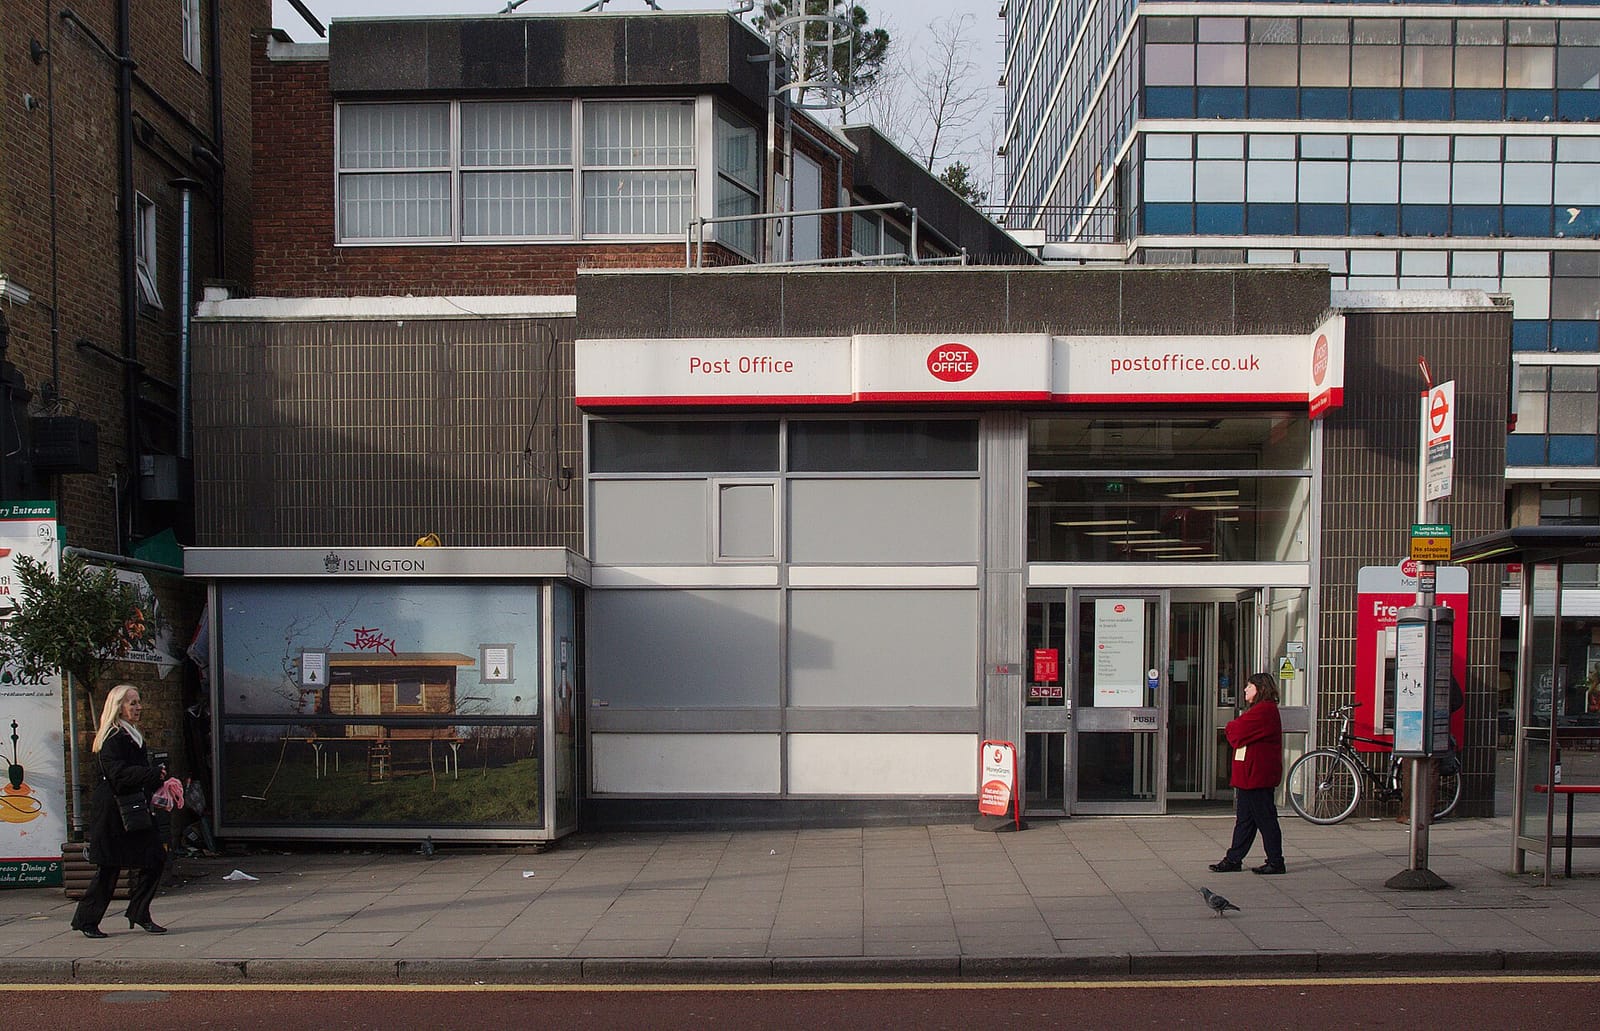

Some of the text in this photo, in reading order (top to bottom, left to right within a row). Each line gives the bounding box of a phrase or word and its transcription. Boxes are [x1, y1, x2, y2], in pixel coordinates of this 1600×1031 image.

[939, 351, 969, 361] POST
[690, 356, 794, 374] Post Office
[931, 362, 973, 372] OFFICE
[1110, 354, 1260, 374] postoffice.co.uk
[12, 505, 51, 514] Entrance
[39, 528, 49, 537] 24
[343, 560, 425, 571] ISLINGTON
[21, 863, 47, 873] Dining
[49, 863, 58, 871] &
[19, 873, 46, 883] Lounge
